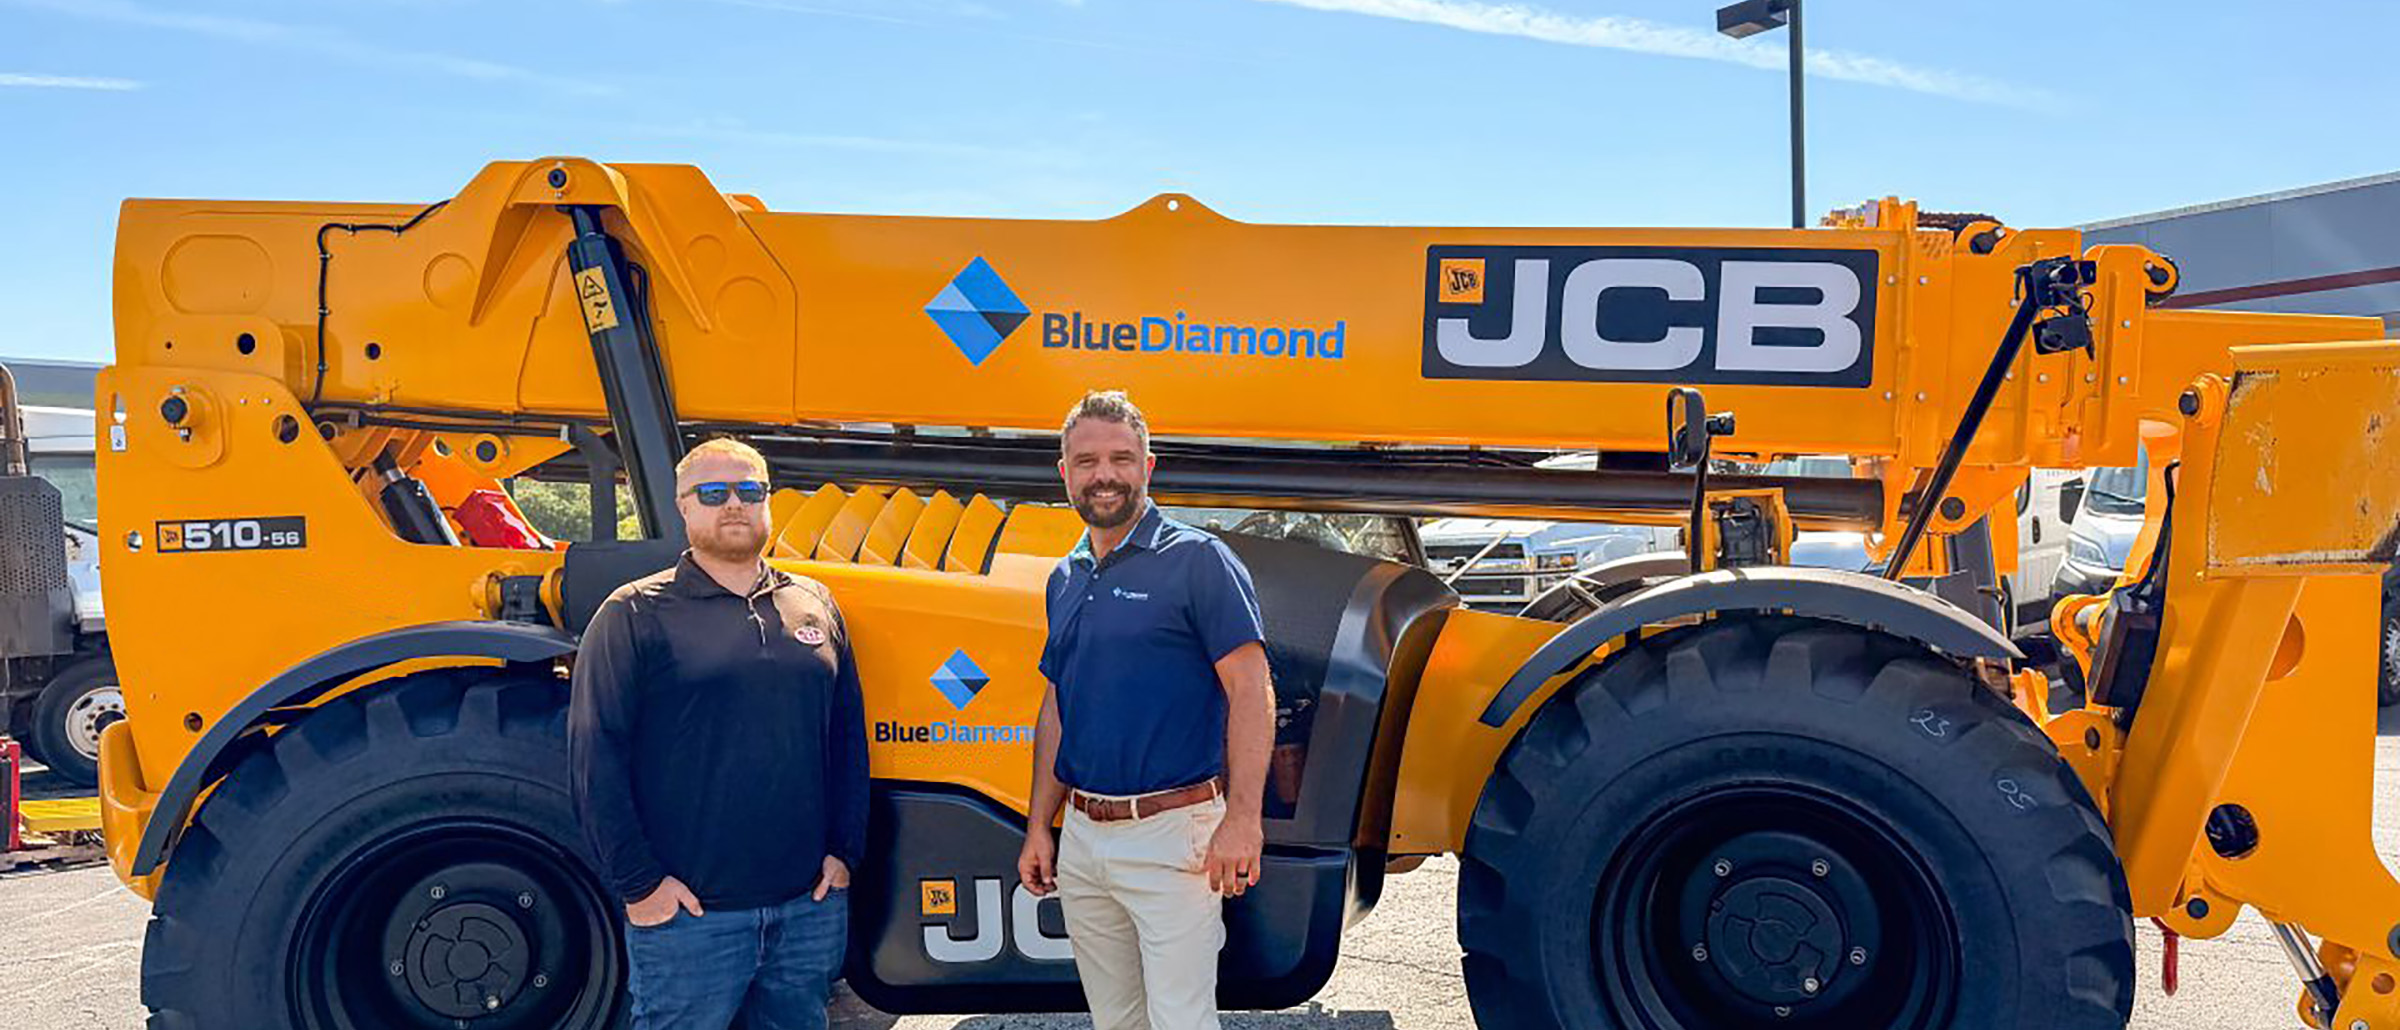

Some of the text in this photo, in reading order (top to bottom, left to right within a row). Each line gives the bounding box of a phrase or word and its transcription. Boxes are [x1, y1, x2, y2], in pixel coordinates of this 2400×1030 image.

[1451, 269, 1478, 291] JCB
[1042, 310, 1346, 359] BlueDiamond
[1437, 258, 1862, 373] JCB
[184, 520, 300, 550] 510-56
[924, 879, 1075, 963] JC
